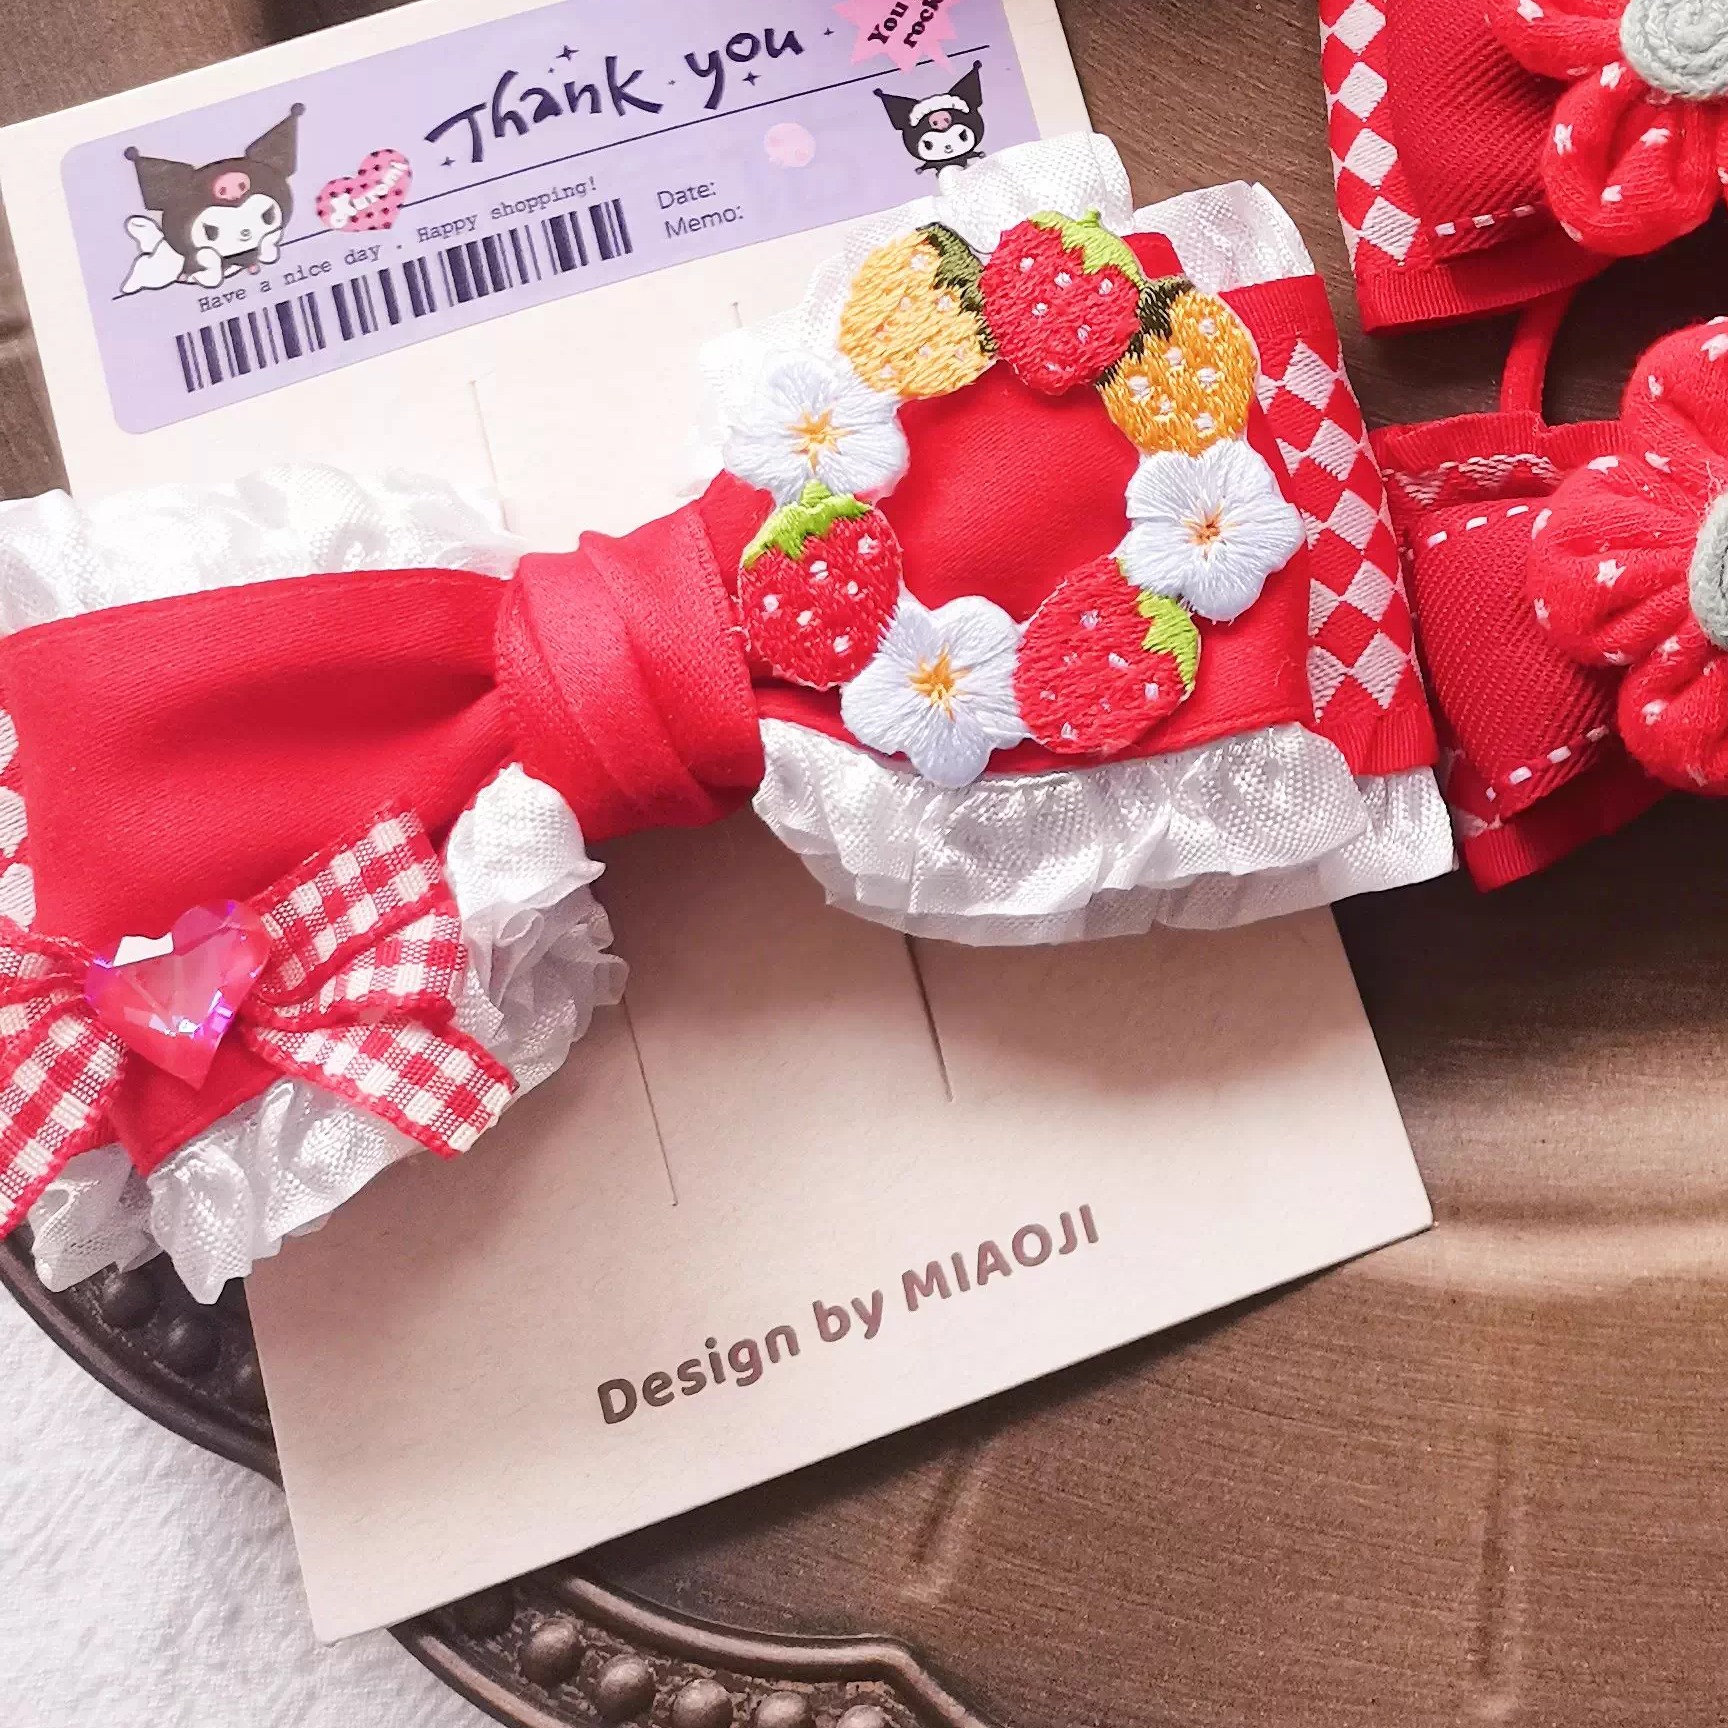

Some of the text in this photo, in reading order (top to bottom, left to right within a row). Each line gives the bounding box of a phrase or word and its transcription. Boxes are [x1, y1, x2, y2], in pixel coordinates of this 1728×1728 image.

[867, 1, 910, 45] You
[424, 27, 805, 163] Thank you
[657, 181, 717, 210] Date:
[664, 205, 744, 239] Memo:
[198, 176, 597, 312] Have a nice day Happy shopping!
[597, 1204, 1099, 1424] Design by MIAOJI
